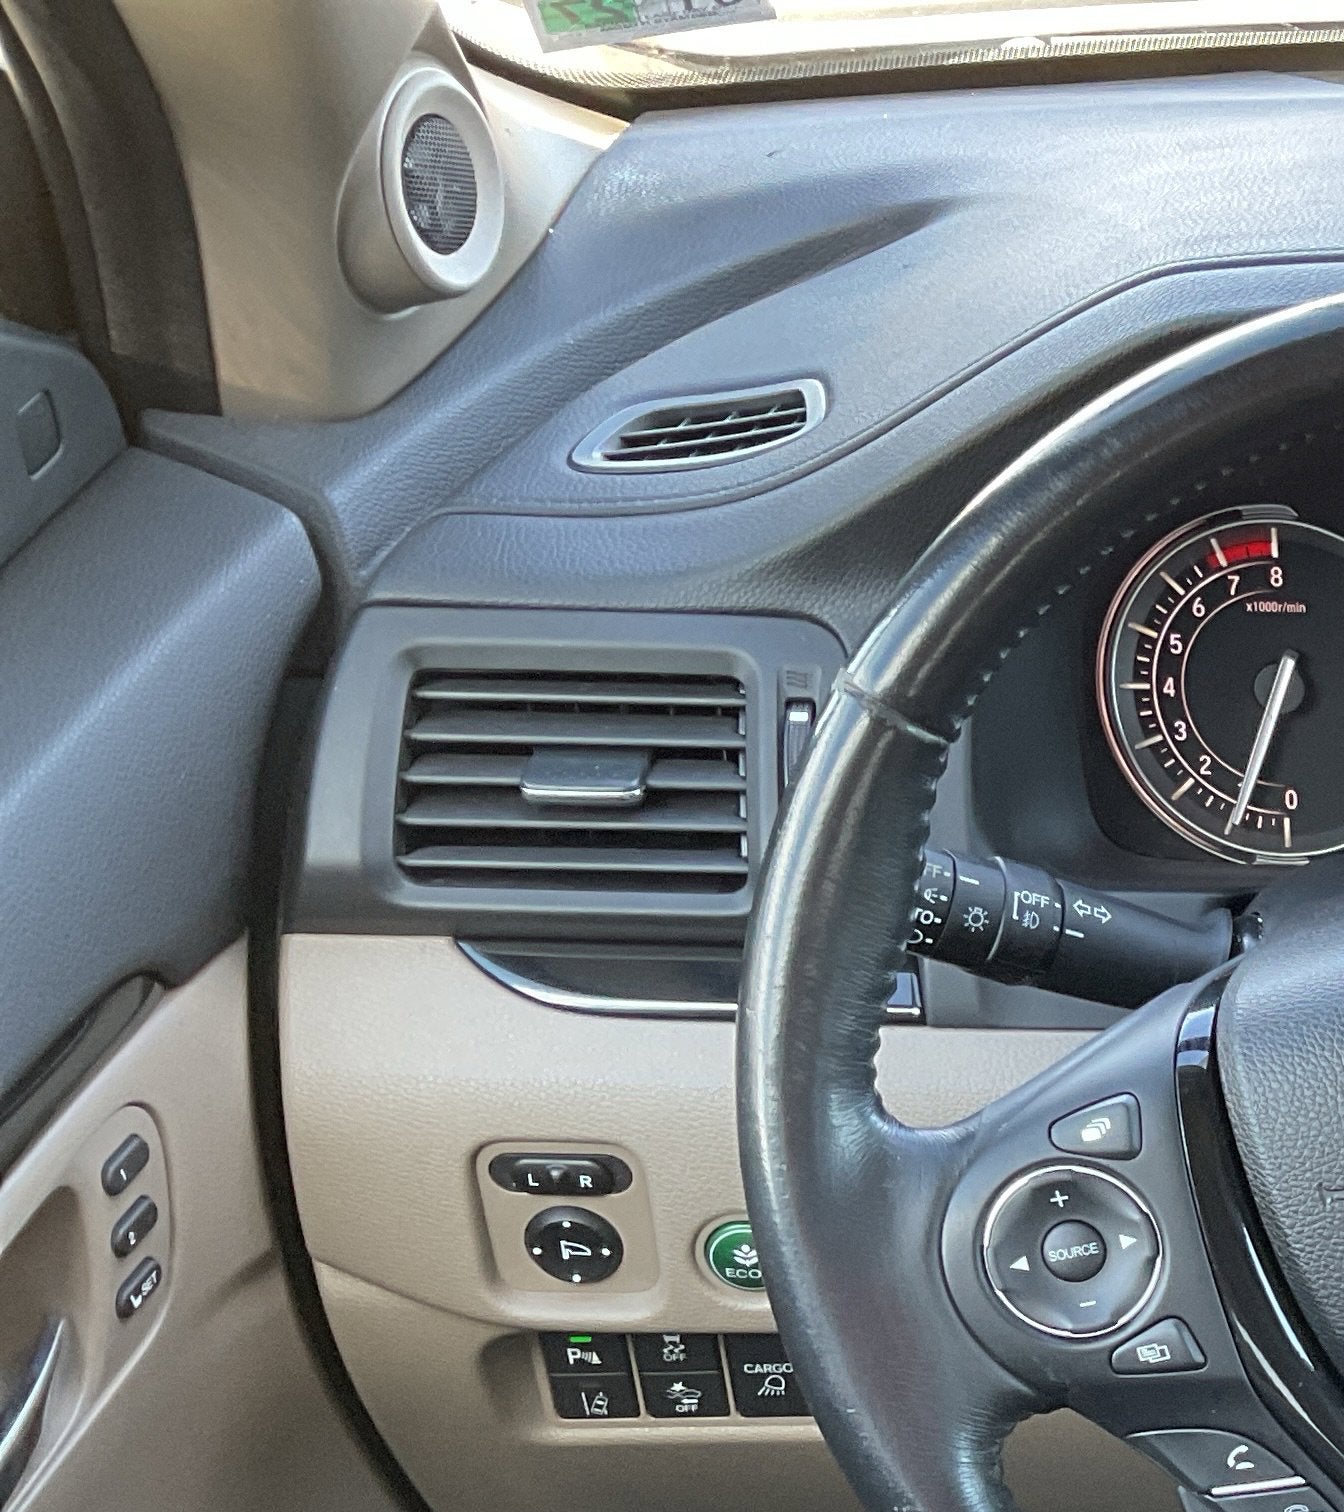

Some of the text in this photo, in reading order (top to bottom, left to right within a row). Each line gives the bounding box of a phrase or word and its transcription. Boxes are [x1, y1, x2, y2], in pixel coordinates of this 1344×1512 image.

[1227, 575, 1240, 596] 7
[1269, 566, 1283, 588] 8
[1192, 597, 1205, 617] 6
[1246, 601, 1306, 613] x1000r/min
[1169, 634, 1182, 654] 5
[1163, 677, 1175, 697] 4
[1173, 720, 1187, 741] 3
[1199, 755, 1212, 775] 2
[1284, 789, 1298, 810] 0
[1019, 891, 1050, 908] OFF
[527, 1173, 593, 1189] L R
[1048, 1240, 1099, 1263] SOURCE
[725, 1267, 763, 1280] ECO
[743, 1362, 794, 1374] CARGO
